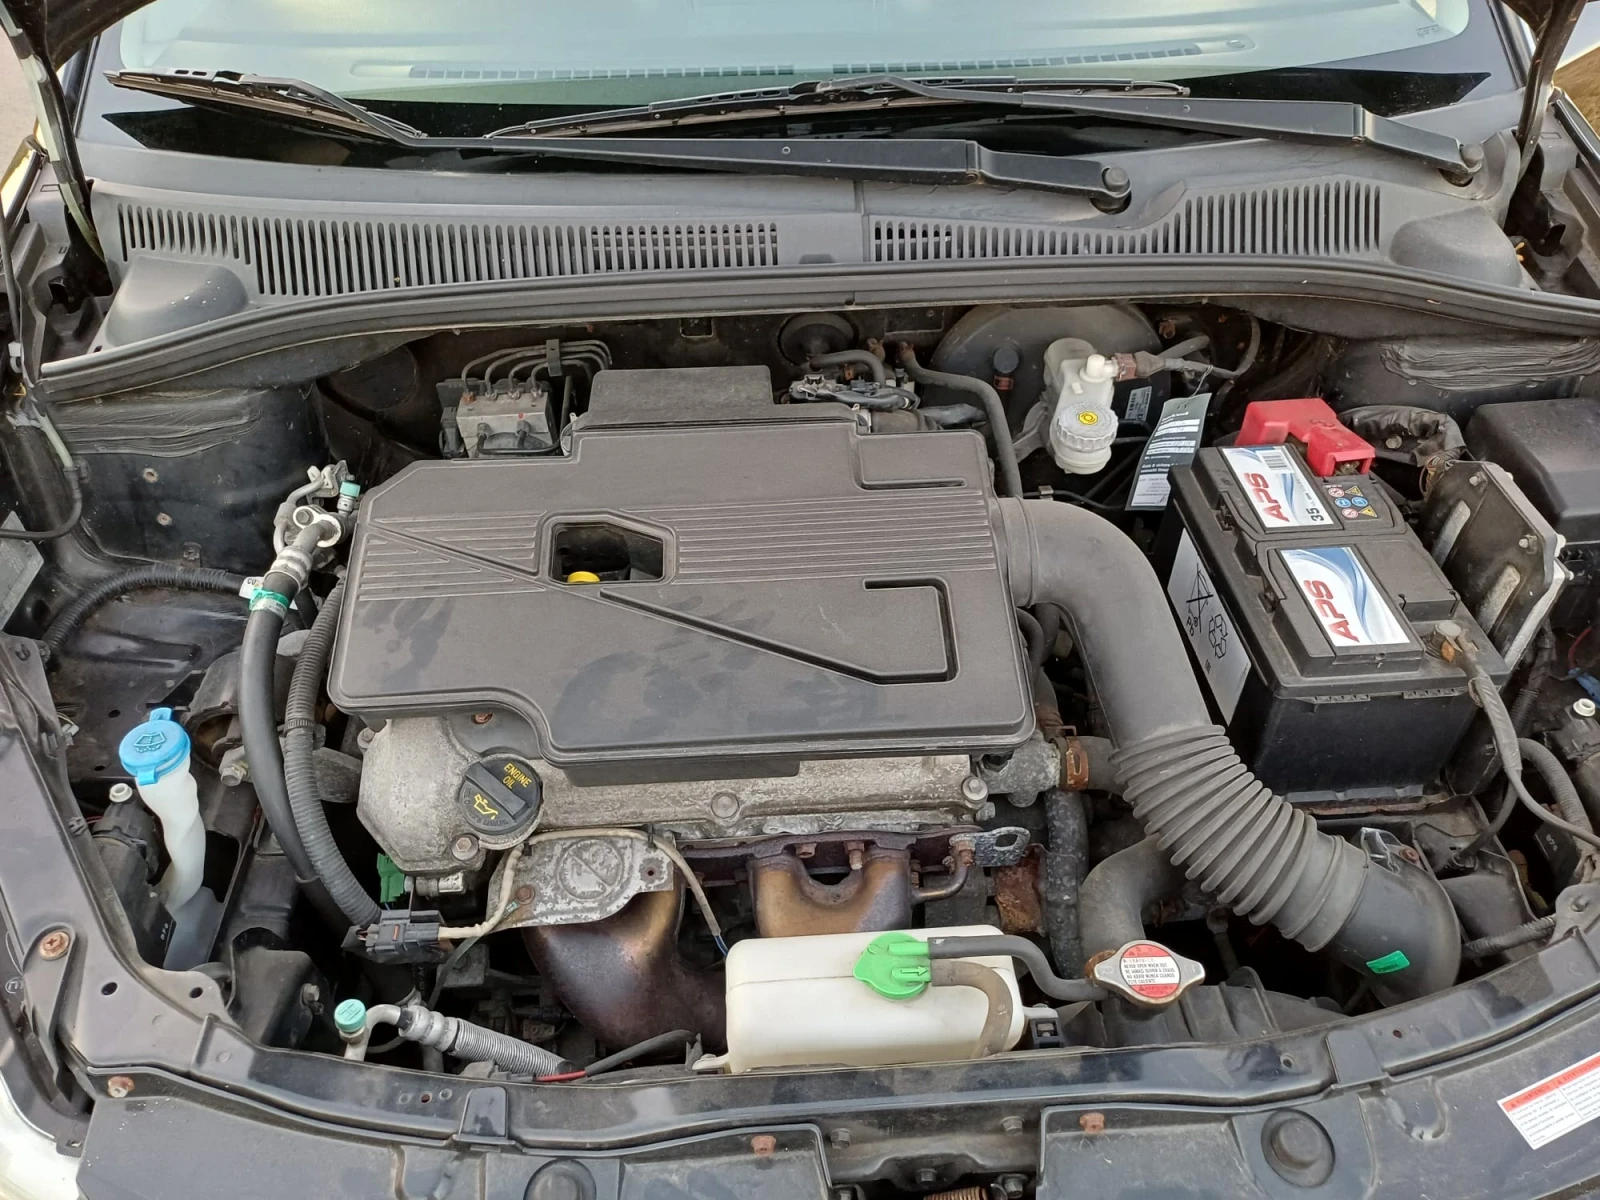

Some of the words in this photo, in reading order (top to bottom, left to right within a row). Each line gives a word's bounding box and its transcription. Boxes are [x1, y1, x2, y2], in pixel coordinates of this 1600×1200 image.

[1243, 472, 1290, 523] APS
[1305, 508, 1324, 522] 35
[1303, 579, 1360, 643] APS
[502, 776, 516, 789] OIL
[503, 762, 532, 788] ENGINE
